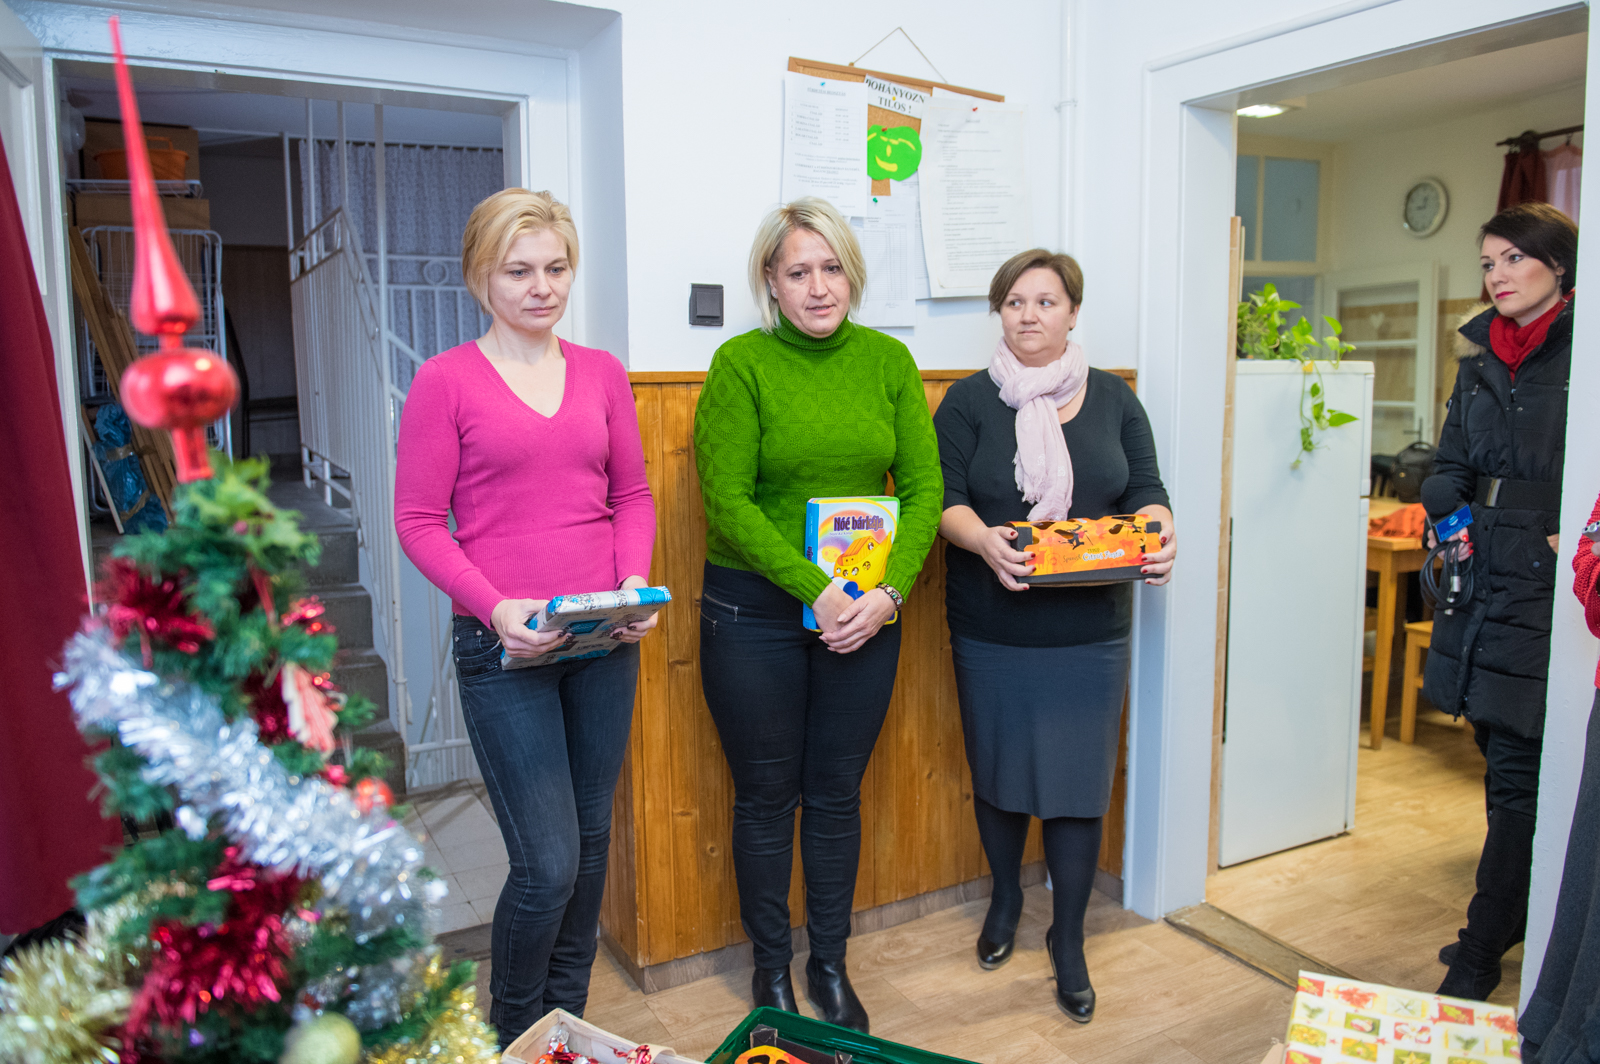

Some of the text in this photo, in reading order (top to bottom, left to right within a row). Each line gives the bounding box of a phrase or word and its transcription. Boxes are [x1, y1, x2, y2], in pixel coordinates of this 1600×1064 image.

[878, 96, 906, 112] TILOS
[834, 515, 884, 532] Nóé bárkája
